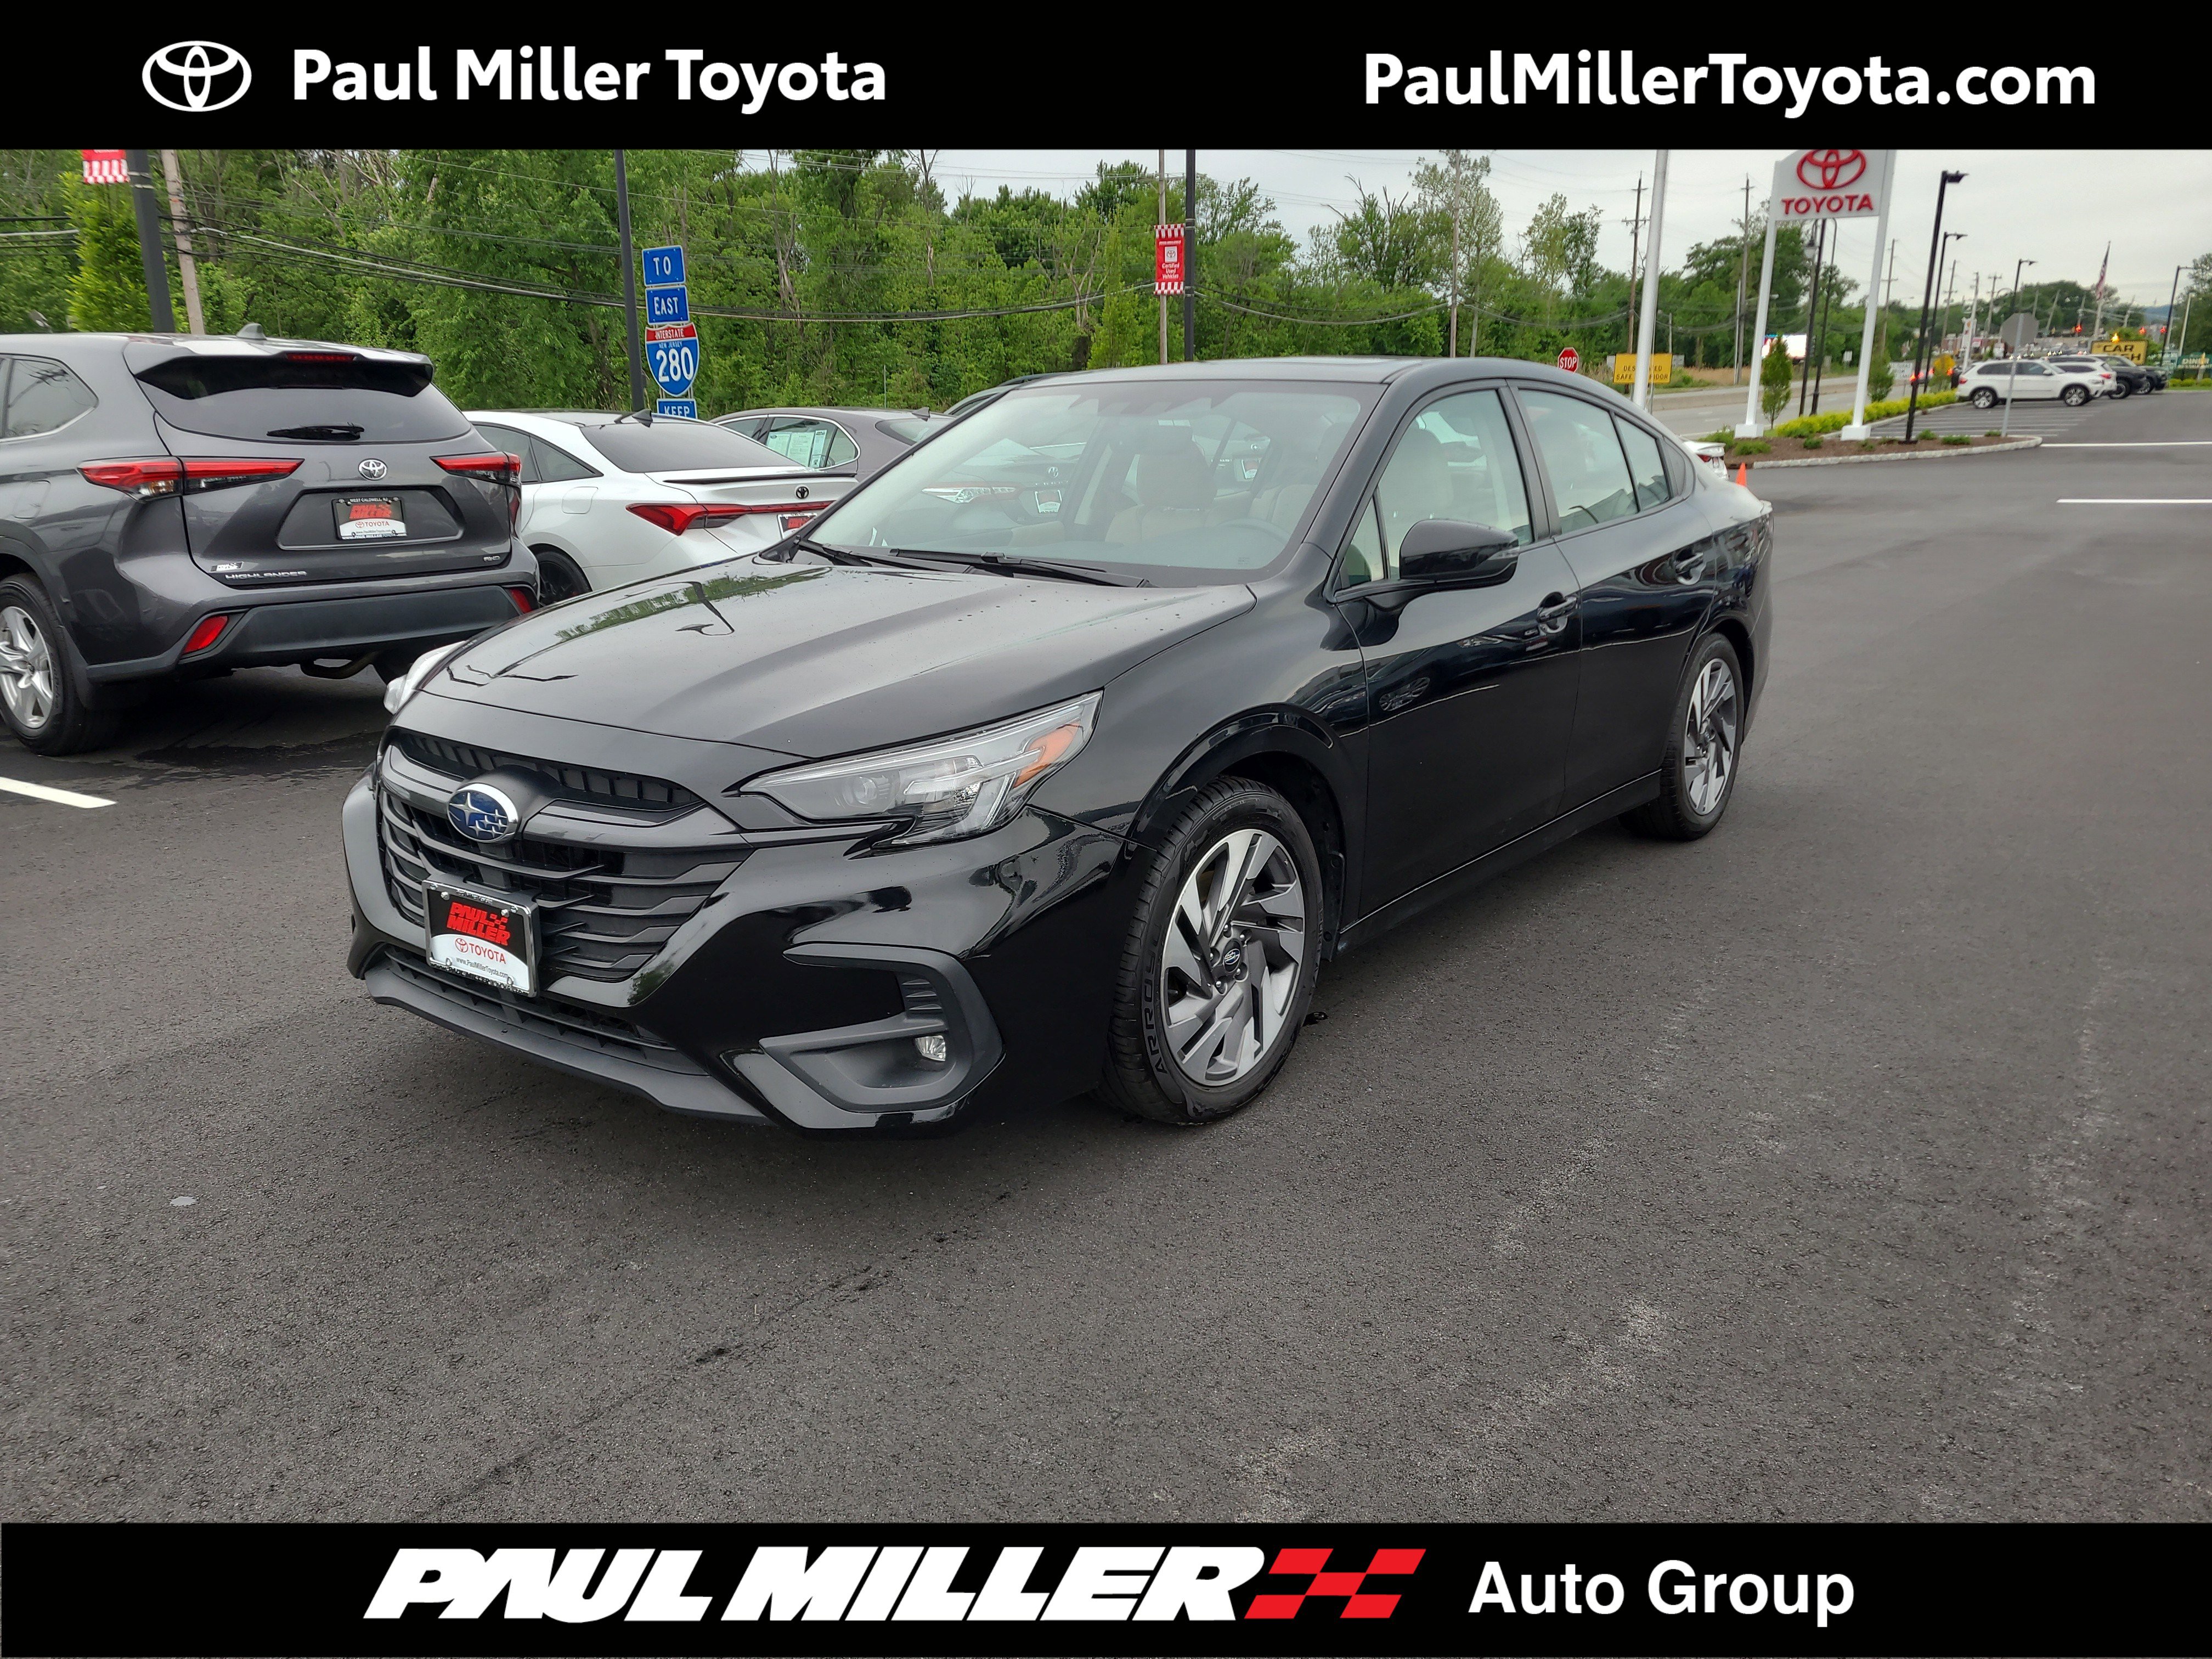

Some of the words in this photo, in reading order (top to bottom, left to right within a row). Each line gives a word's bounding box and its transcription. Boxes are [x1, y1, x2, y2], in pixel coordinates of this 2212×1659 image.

[1781, 193, 1874, 215] TOYOTA
[653, 256, 672, 276] TO
[653, 297, 679, 316] EAST
[655, 329, 684, 340] INTERSTATE
[656, 347, 694, 382] 280
[1559, 357, 1577, 369] STOP
[225, 571, 307, 580] HIGHLANDER
[449, 901, 495, 927] PAUL
[446, 915, 511, 946] MILLER
[469, 943, 507, 964] TOYOTA
[455, 957, 509, 979] www.PaulMillerToyota.com
